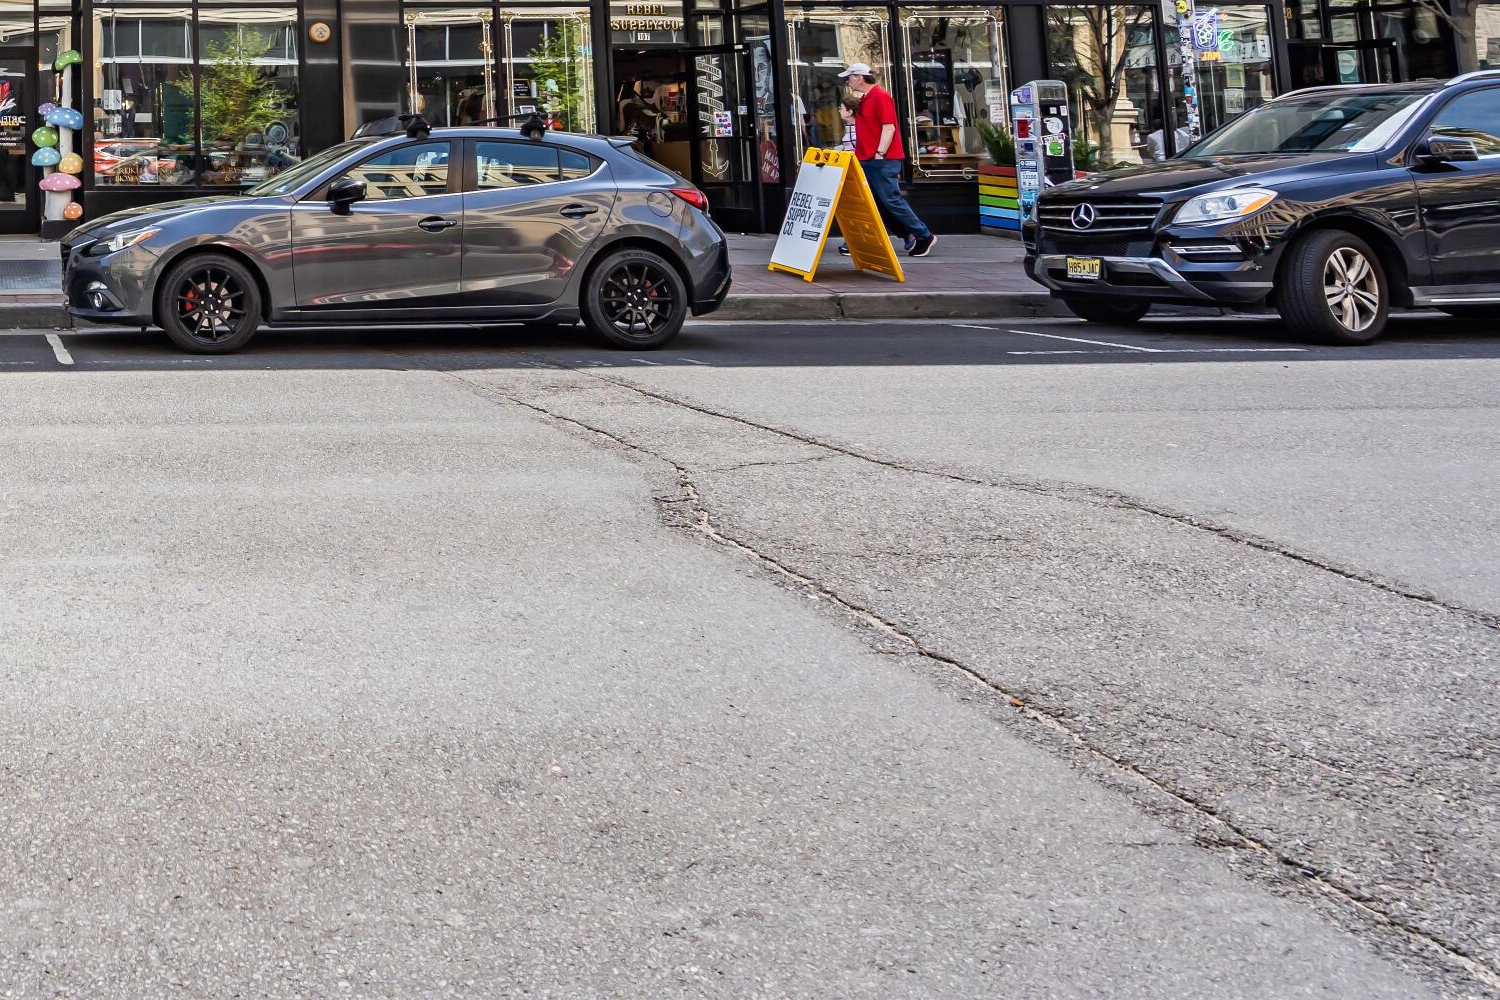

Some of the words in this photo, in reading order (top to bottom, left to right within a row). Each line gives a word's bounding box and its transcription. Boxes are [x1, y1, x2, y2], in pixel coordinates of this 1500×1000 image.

[627, 4, 667, 15] REBEL
[612, 20, 661, 31] SUPPLY
[790, 192, 814, 209] REBEL
[787, 207, 814, 224] SUPPLY
[783, 221, 794, 235] CO.
